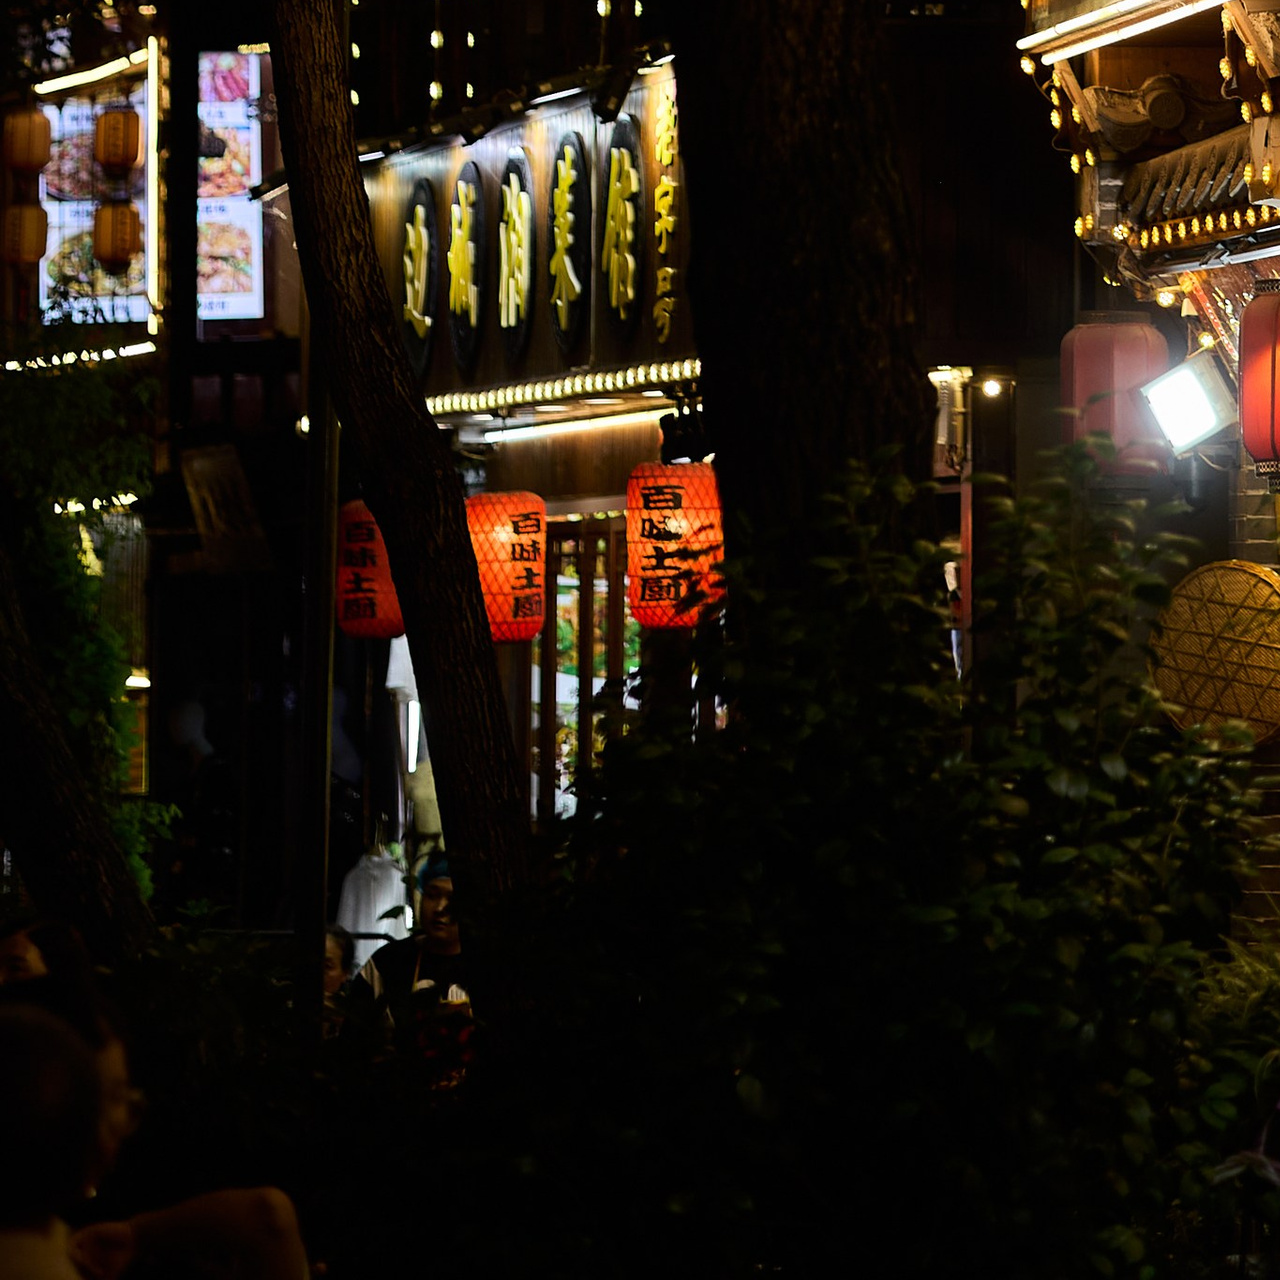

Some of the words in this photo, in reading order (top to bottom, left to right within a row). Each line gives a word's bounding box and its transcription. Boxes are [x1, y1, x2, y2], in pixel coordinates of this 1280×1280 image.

[344, 521, 376, 619] 百味土厨
[510, 511, 541, 619] 百味土厨
[641, 485, 686, 601] 百味土厨
